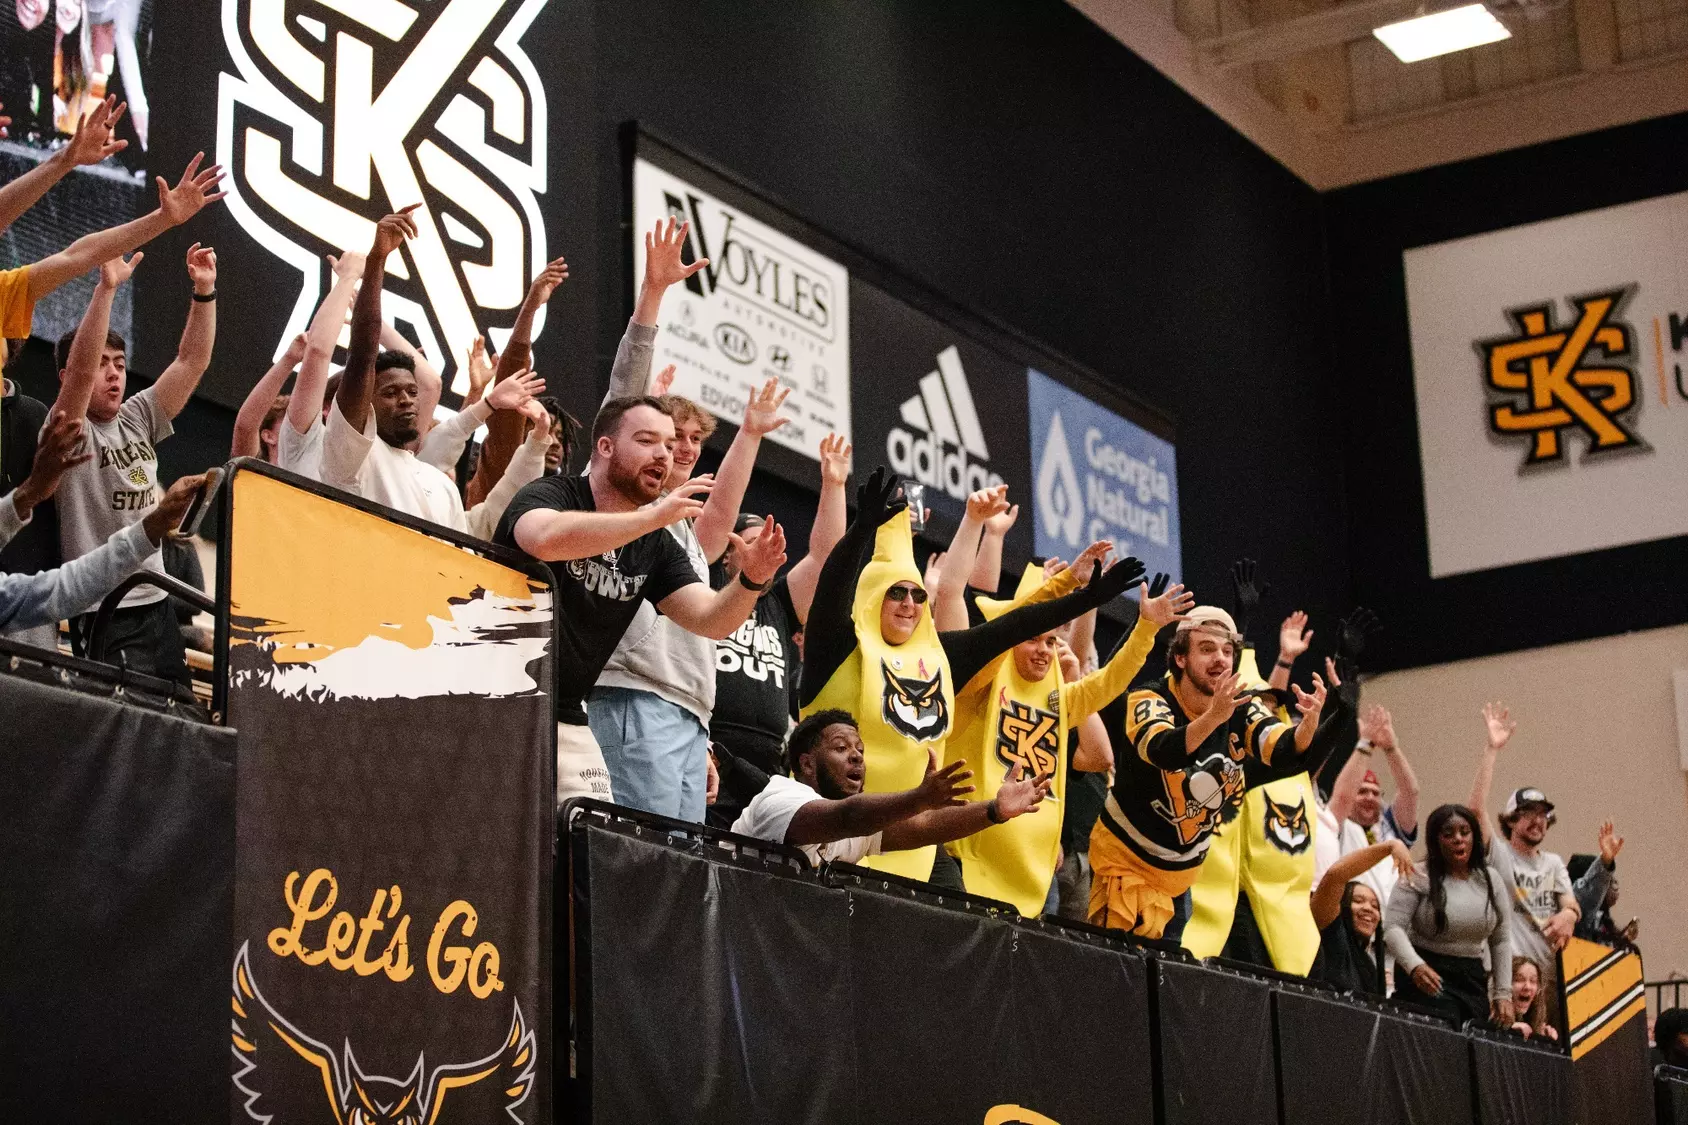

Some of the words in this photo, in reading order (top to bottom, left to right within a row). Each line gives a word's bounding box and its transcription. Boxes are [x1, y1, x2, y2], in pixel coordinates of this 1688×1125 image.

[686, 192, 829, 329] VOYLES
[1085, 427, 1170, 503] Georgia
[1087, 473, 1169, 546] Natural
[716, 648, 785, 689] OUT
[1228, 732, 1246, 762] C
[267, 868, 414, 982] Let's
[426, 900, 504, 999] Go
